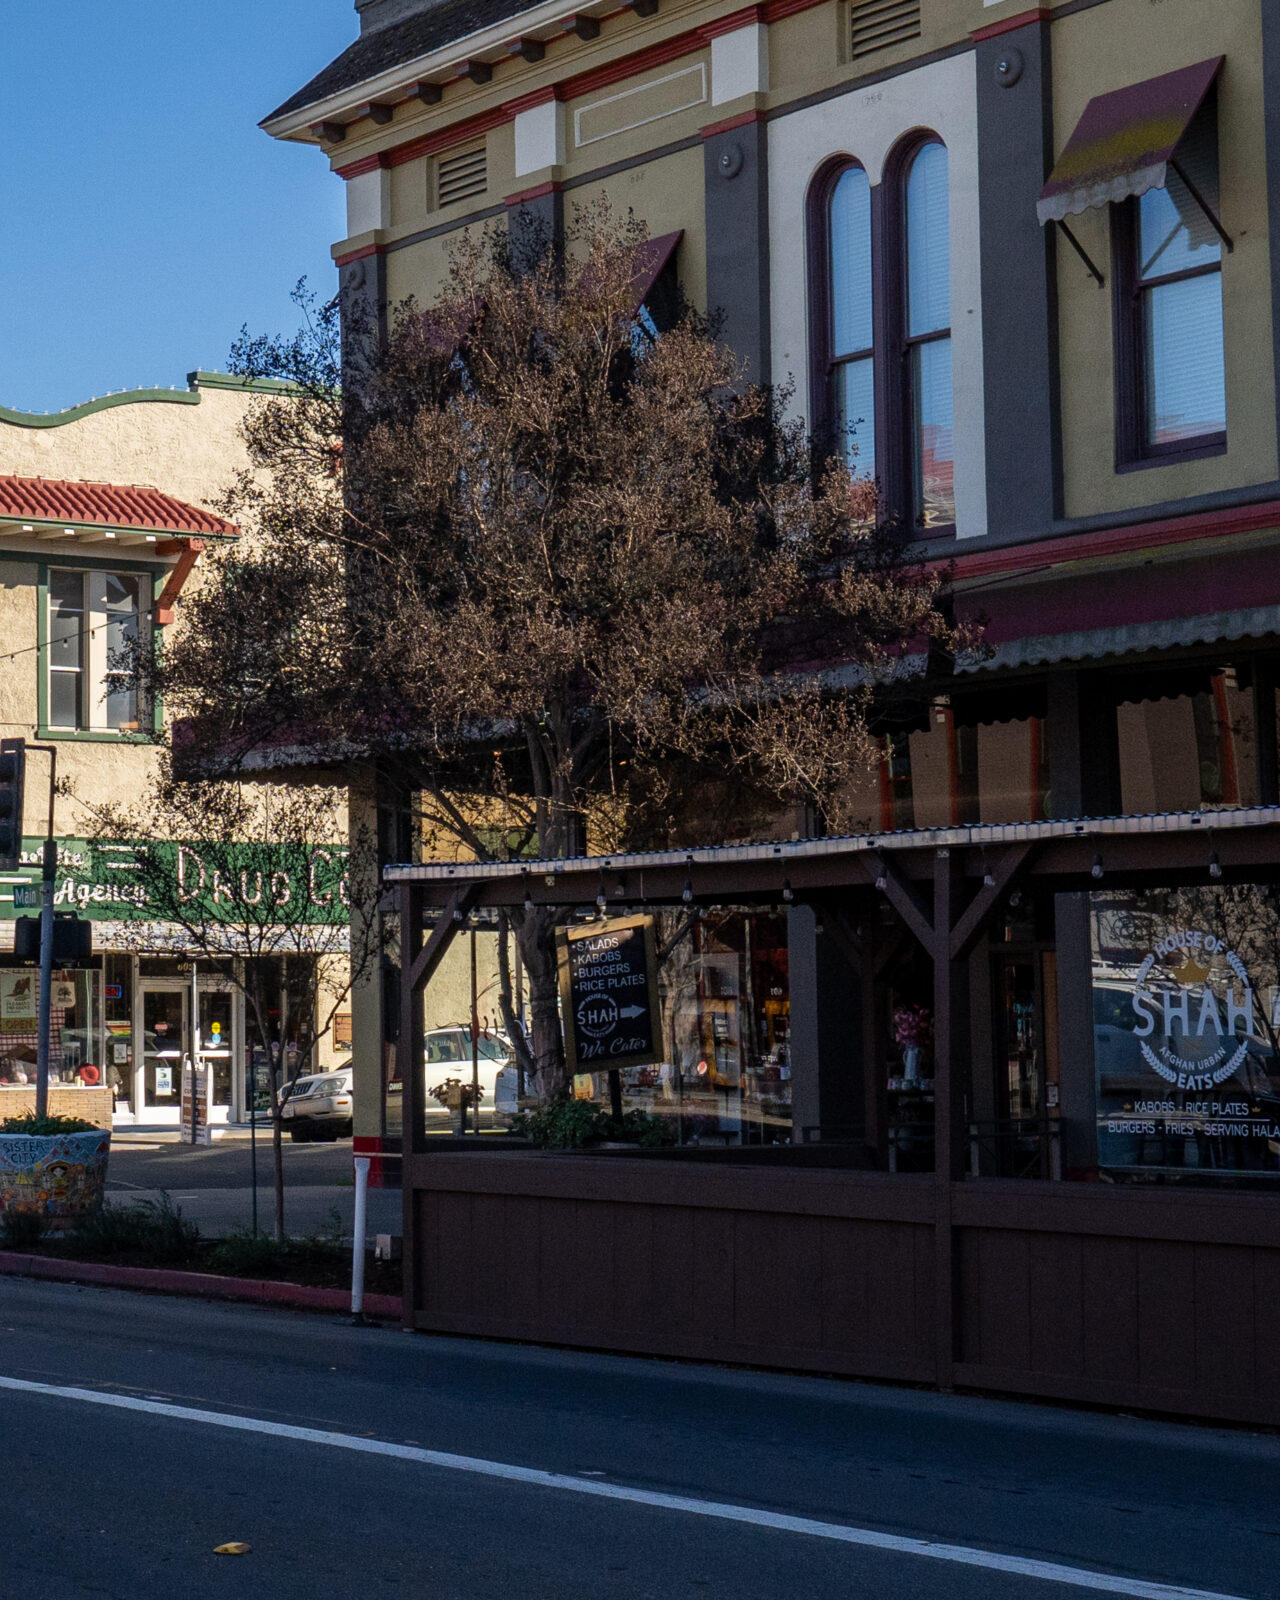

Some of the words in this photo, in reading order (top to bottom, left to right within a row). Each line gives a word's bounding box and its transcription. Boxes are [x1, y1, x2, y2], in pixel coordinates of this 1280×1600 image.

[15, 888, 37, 905] Main
[577, 937, 619, 951] SALADS
[1154, 930, 1202, 960] HOUSE
[1204, 934, 1226, 954] OF
[577, 950, 621, 965] KABOBS
[578, 963, 631, 979] BURGERS
[580, 979, 606, 992] RICE
[608, 973, 646, 989] PLATES
[577, 1007, 618, 1024] SHAH
[1132, 988, 1255, 1037] SHAH
[580, 1039, 606, 1059] We
[1158, 1045, 1195, 1071] AFGHAN
[1197, 1045, 1227, 1070] URBAN
[1177, 1072, 1214, 1091] EATS
[1134, 1100, 1175, 1113] KABOBS
[1185, 1102, 1209, 1114] RICE
[1211, 1102, 1249, 1116] PLATES
[1108, 1120, 1155, 1134] BURGERS
[1165, 1121, 1194, 1135] FRIES
[1204, 1122, 1249, 1137] SERVING
[2, 1142, 45, 1153] SISTER
[10, 1153, 37, 1164] CITY
